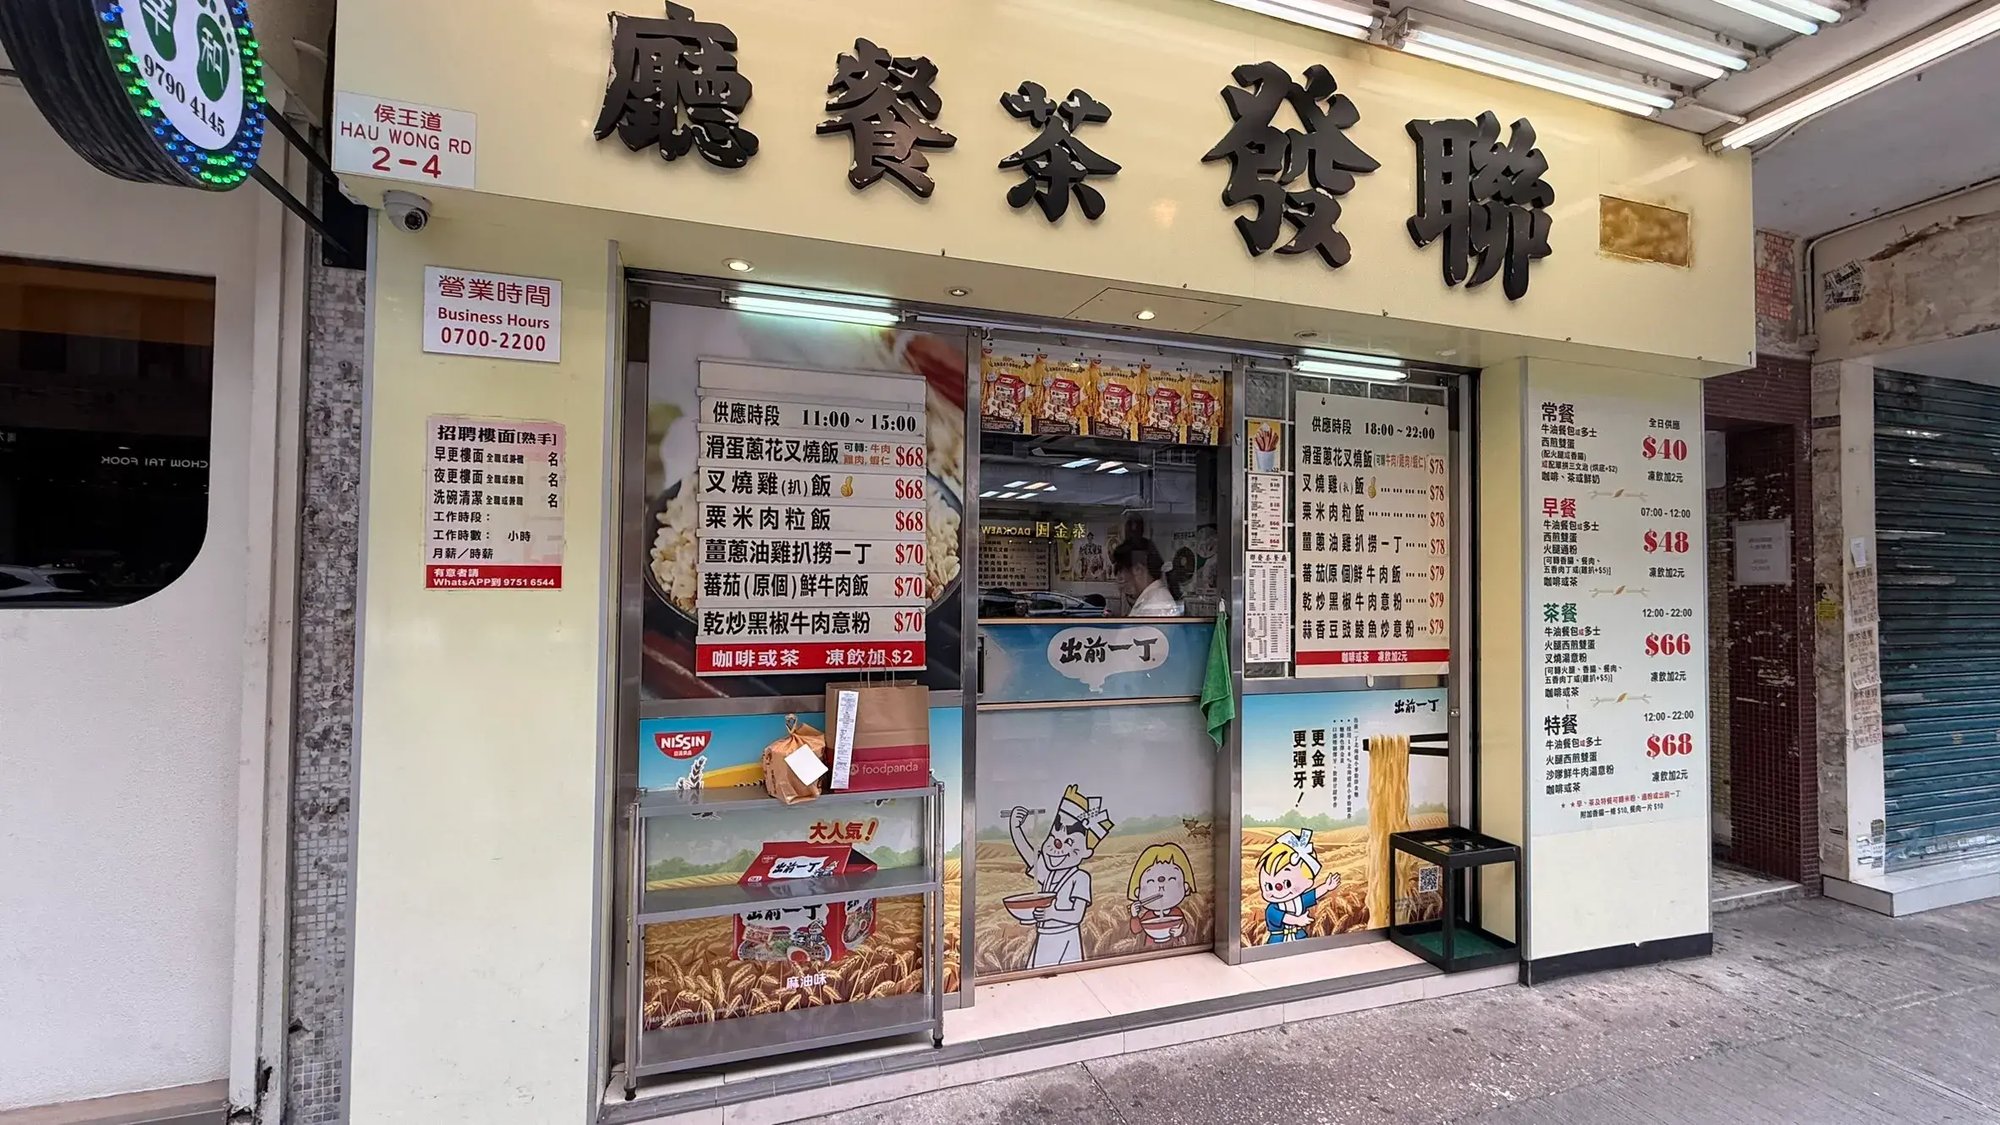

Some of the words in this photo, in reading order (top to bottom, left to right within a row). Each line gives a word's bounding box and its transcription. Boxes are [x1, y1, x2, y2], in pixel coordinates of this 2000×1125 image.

[144, 54, 186, 104] 9790
[190, 96, 226, 138] 4145
[374, 104, 442, 132] 侯王道
[340, 121, 379, 141] HAU
[389, 128, 440, 151] WONG
[448, 138, 472, 155] RD
[438, 275, 551, 308] 營業時間
[438, 307, 503, 325] Business
[507, 313, 550, 329] Hours
[441, 326, 546, 352] 0700-2200
[712, 400, 780, 428] 供應時段
[802, 408, 850, 429] 11:00
[870, 414, 917, 433] 15:00
[1541, 402, 1575, 424] 常餐
[1648, 418, 1681, 430] 全日供應
[1312, 416, 1352, 436] 供應時段
[1364, 422, 1394, 436] 18:00
[1405, 425, 1436, 440] 22:00
[434, 446, 484, 464] 早更樓面
[548, 452, 558, 468] 名
[706, 434, 839, 466] 滑蛋蔥花叉燒飯
[870, 444, 891, 454] 牛肉
[895, 444, 924, 468] $68
[1642, 434, 1688, 462] $40
[1429, 458, 1445, 475] $78
[434, 468, 484, 485] 夜更樓面
[548, 472, 559, 488] 名
[705, 470, 832, 498] 叉燒雞(扒)飯
[894, 477, 924, 500] $68
[434, 489, 484, 506] 洗碗清潔
[548, 493, 558, 508] 名
[1429, 485, 1445, 502] $78
[1542, 498, 1576, 519] 早餐
[1640, 507, 1663, 518] 07:00
[1670, 508, 1691, 518] 12:00
[894, 510, 924, 534] $68
[1430, 512, 1446, 528] $78
[508, 530, 532, 543] 小時
[1430, 538, 1446, 555] $78
[1642, 528, 1690, 554] $48
[704, 539, 872, 566] 薑蔥油雞扒撈一丁
[894, 542, 924, 566] $70
[434, 568, 479, 578] 有意者請
[503, 578, 528, 587] 9751
[530, 578, 555, 587] 6544
[1430, 565, 1445, 582] $79
[704, 572, 870, 599] 蕃茄(原個)鮮牛肉飯
[894, 576, 923, 599] $70
[1302, 592, 1402, 612] 乾炒黑椒牛肉意粉
[1429, 592, 1445, 608] $79
[1543, 602, 1578, 624] 茶餐
[1642, 608, 1665, 618] 12:00
[1670, 608, 1692, 618] 22:00
[703, 611, 871, 636] 乾炒黑椒牛肉意粉
[894, 612, 923, 634] $70
[1429, 619, 1445, 636] $79
[1059, 636, 1158, 664] 出前一丁
[1644, 632, 1691, 658] $66
[712, 649, 800, 668] 咖啡或茶
[1394, 698, 1440, 714] 出前一丁
[1644, 712, 1666, 722] 12:00
[1672, 710, 1694, 720] 22:00
[1544, 714, 1578, 736] 特餐
[661, 734, 706, 750] NISSIN
[1646, 732, 1693, 760] $68
[862, 762, 920, 776] foodpanda
[1311, 728, 1326, 790] 更金黃
[772, 860, 822, 874] 出前一丁
[786, 972, 827, 990] 麻油味
